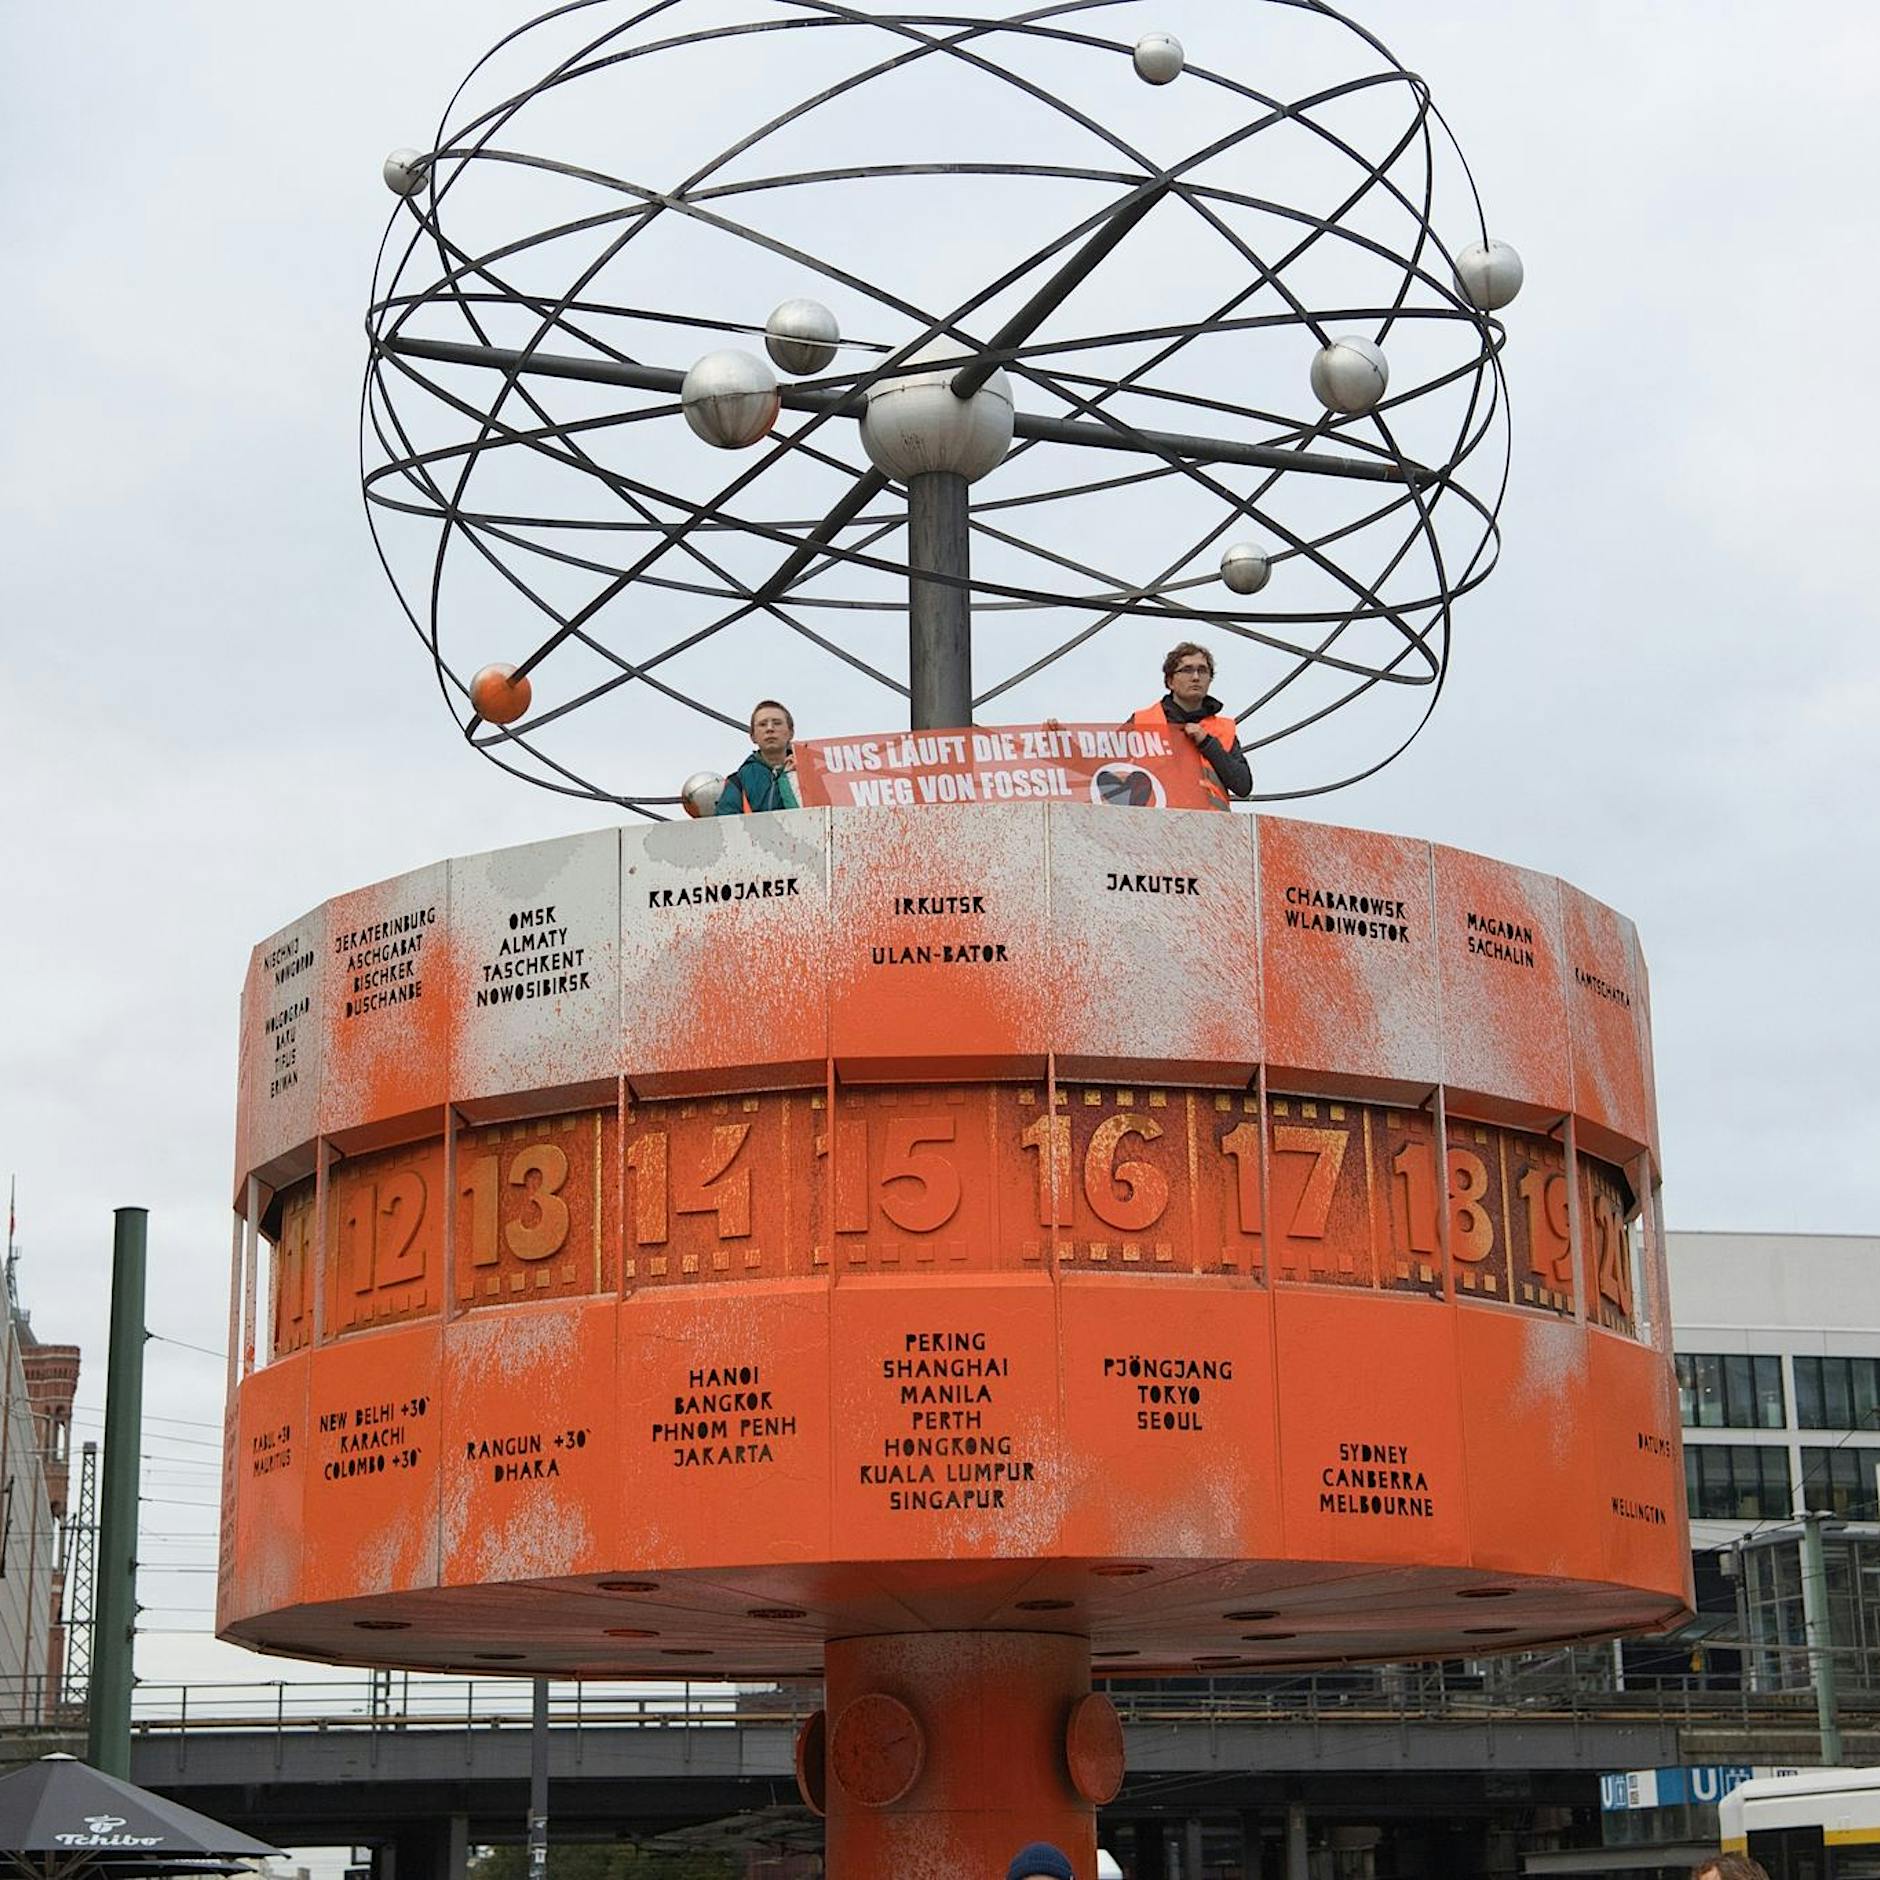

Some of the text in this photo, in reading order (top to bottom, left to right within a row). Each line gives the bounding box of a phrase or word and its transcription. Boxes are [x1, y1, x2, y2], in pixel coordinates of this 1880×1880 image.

[824, 731, 1173, 774] UNS LÄUFT DIE ZEIT DAVON:
[849, 768, 1073, 806] WEG VON FOSSIL
[649, 878, 801, 909] KRASNOJARSK
[1106, 873, 1200, 896] JAKUTSK
[895, 896, 986, 916] IRKUTSK
[1286, 886, 1406, 919] CHABAROWSK
[335, 907, 436, 954] JEKATERINBURG
[509, 906, 557, 930] OMSK
[1285, 910, 1410, 943] WLADIWOSTOK
[1467, 913, 1533, 944] MAGADAN
[347, 934, 423, 973] ASCHGABAT
[500, 928, 568, 957] ALMATY
[872, 944, 1009, 966] ULAN-BATOR
[1468, 936, 1534, 968] SACHALIN
[353, 960, 414, 993] BISCHKEK
[483, 949, 585, 983] TASCHKENT
[346, 981, 423, 1018] DUSCHANBE
[476, 972, 591, 1008] NOWOSIBIRSK
[627, 1122, 752, 1244] 14
[816, 1116, 962, 1233] 15
[1021, 1112, 1169, 1232] 16
[1221, 1121, 1350, 1239] 17
[462, 1143, 571, 1268] 13
[1393, 1141, 1494, 1263] 18
[348, 1169, 428, 1294] 12
[1520, 1168, 1574, 1282] 19
[905, 1332, 986, 1353] PEKING
[689, 1366, 759, 1389] HANOI
[883, 1358, 1009, 1378] SHANGHAI
[1104, 1355, 1233, 1380] PJÖNGJANG
[674, 1391, 773, 1416] BANGKOK
[901, 1384, 992, 1404] MANILA
[1138, 1385, 1201, 1405] TOKYO
[319, 1411, 348, 1433] NEW
[355, 1402, 395, 1427] DELHI
[652, 1416, 797, 1443] PHNOM PENH
[912, 1411, 982, 1430] PERTH
[1137, 1411, 1203, 1431] SEOUL
[340, 1426, 405, 1454] KARACHI
[466, 1434, 542, 1461] RANGUN
[885, 1436, 1012, 1458] HONGKONG
[1340, 1443, 1408, 1465] SYDNEY
[324, 1454, 385, 1481] COLOMBO
[674, 1444, 774, 1468] JAKARTA
[494, 1459, 560, 1483] DHAKA
[860, 1461, 1035, 1485] KUALA LUMPUR
[1322, 1468, 1428, 1491] CANBERRA
[889, 1489, 1005, 1510] SINGAPUR
[1319, 1493, 1434, 1517] MELBOURNE
[1611, 1496, 1666, 1525] WELLINGTON
[1601, 1775, 1612, 1808] U
[1692, 1767, 1718, 1801] U
[54, 1833, 165, 1846] Tchibo
